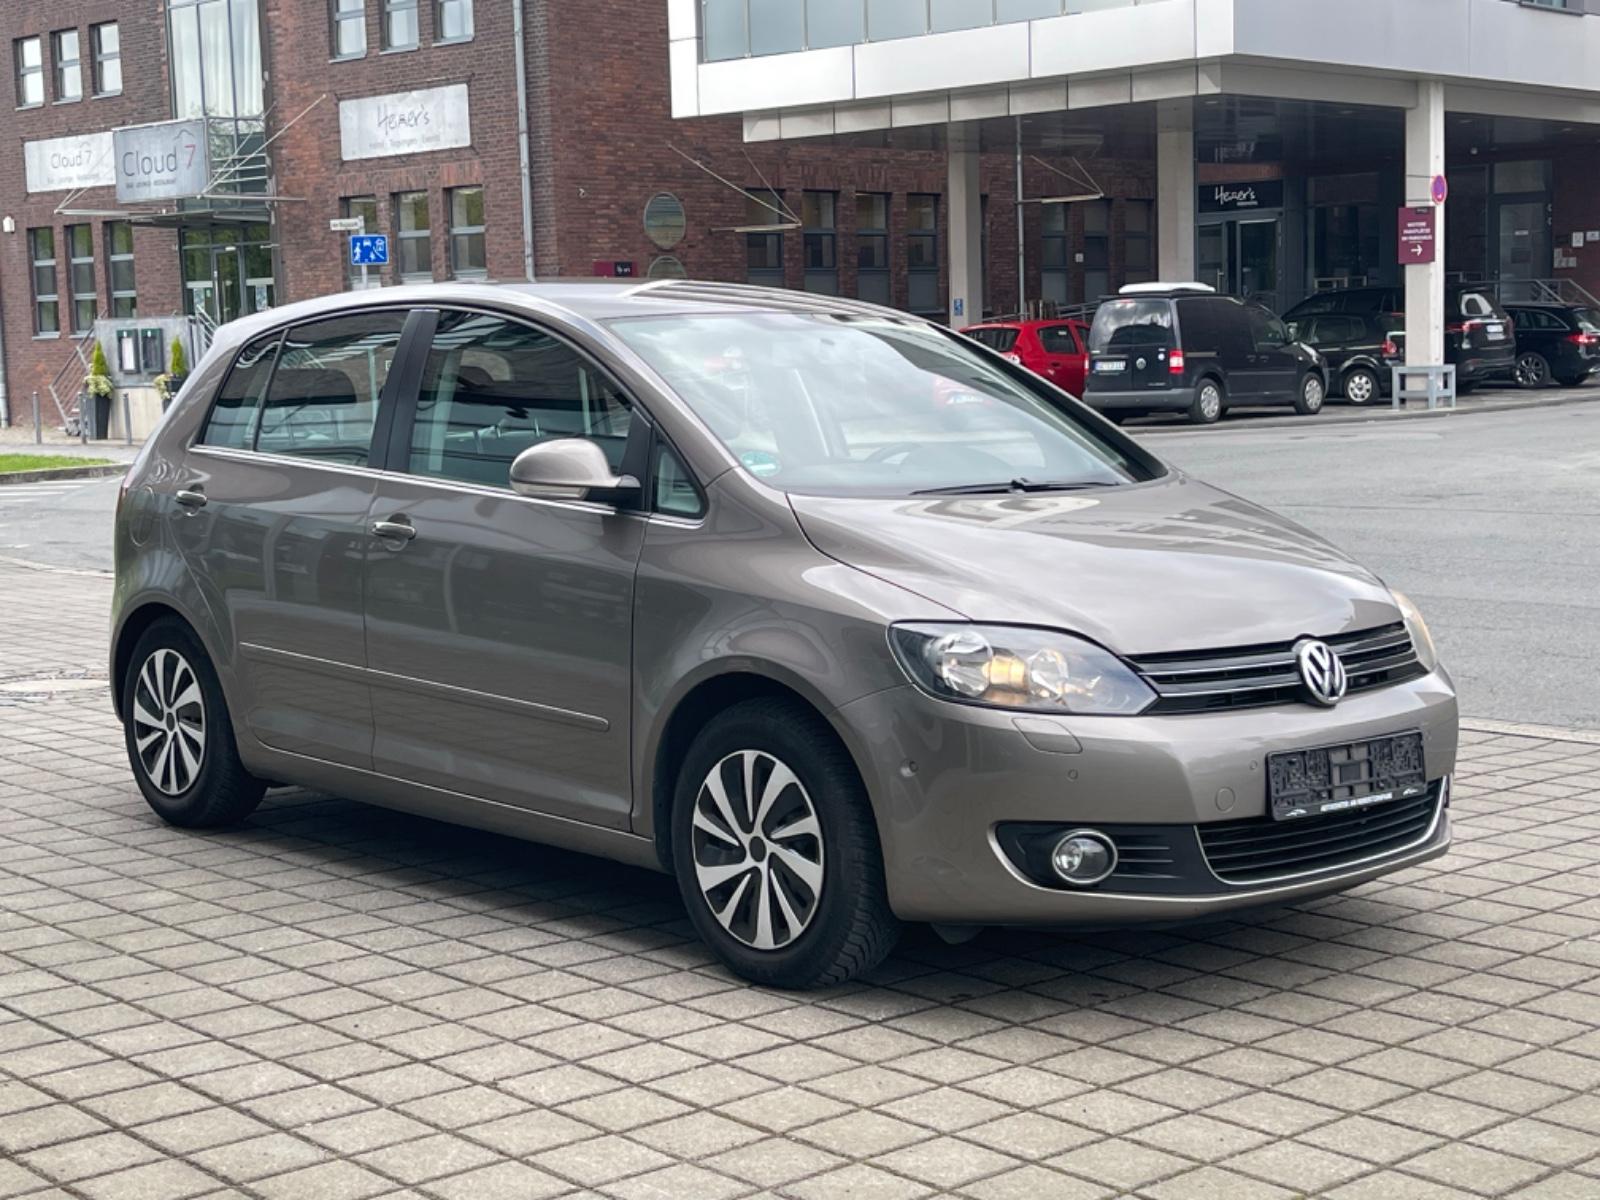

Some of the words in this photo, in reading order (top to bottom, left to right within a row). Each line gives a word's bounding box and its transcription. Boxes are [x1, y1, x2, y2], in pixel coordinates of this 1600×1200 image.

[50, 151, 82, 169] Cloud
[86, 150, 92, 165] 7
[122, 146, 177, 177] Cloud
[184, 144, 196, 169] 7
[1301, 640, 1346, 704] VW
